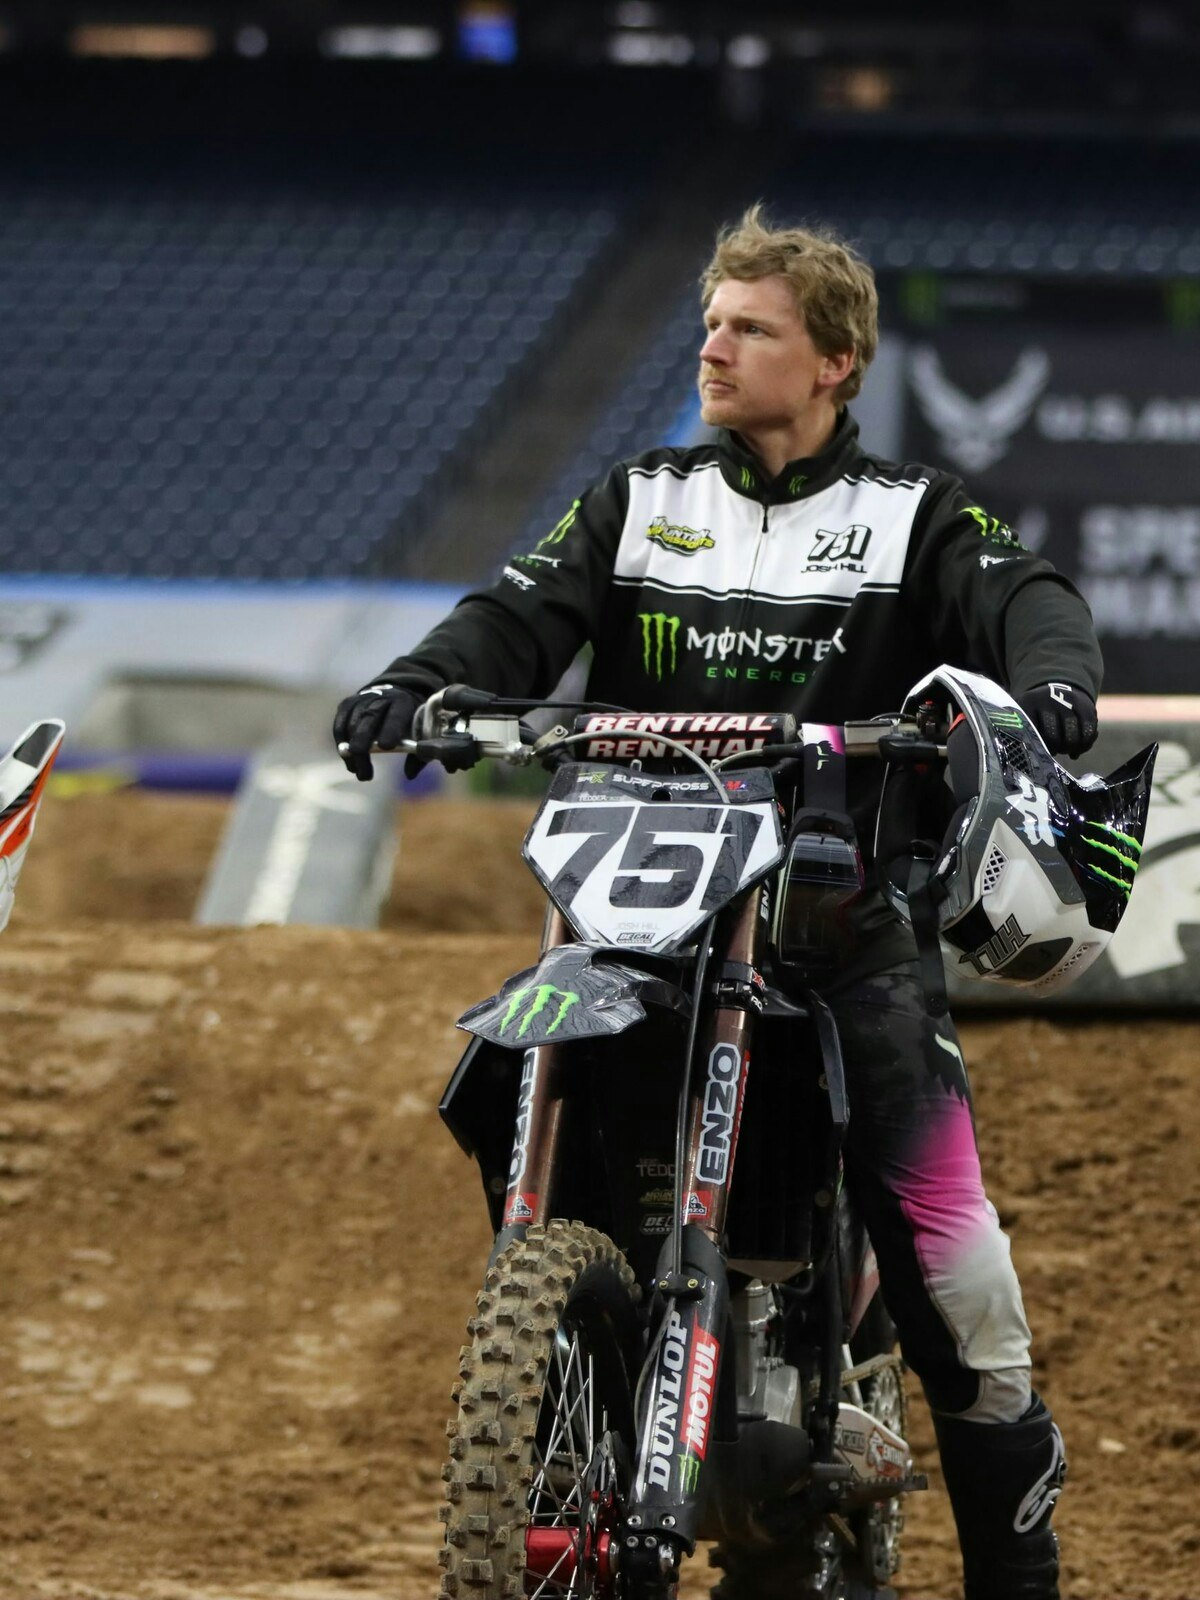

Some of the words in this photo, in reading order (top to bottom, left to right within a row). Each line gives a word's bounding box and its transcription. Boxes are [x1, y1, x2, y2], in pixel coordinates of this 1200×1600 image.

[807, 524, 872, 561] 751
[840, 562, 867, 574] HILL
[707, 667, 817, 684] ENERG
[584, 715, 773, 733] RENTHAL
[586, 738, 767, 758] RENTHAL
[546, 806, 765, 911] 751
[958, 913, 1032, 977] HILL
[506, 1046, 539, 1190] ENZO
[696, 1042, 742, 1186] ENZO
[636, 1164, 676, 1178] TEDD
[648, 1310, 689, 1493] DUNLOP
[686, 1342, 717, 1450] MOTUL
